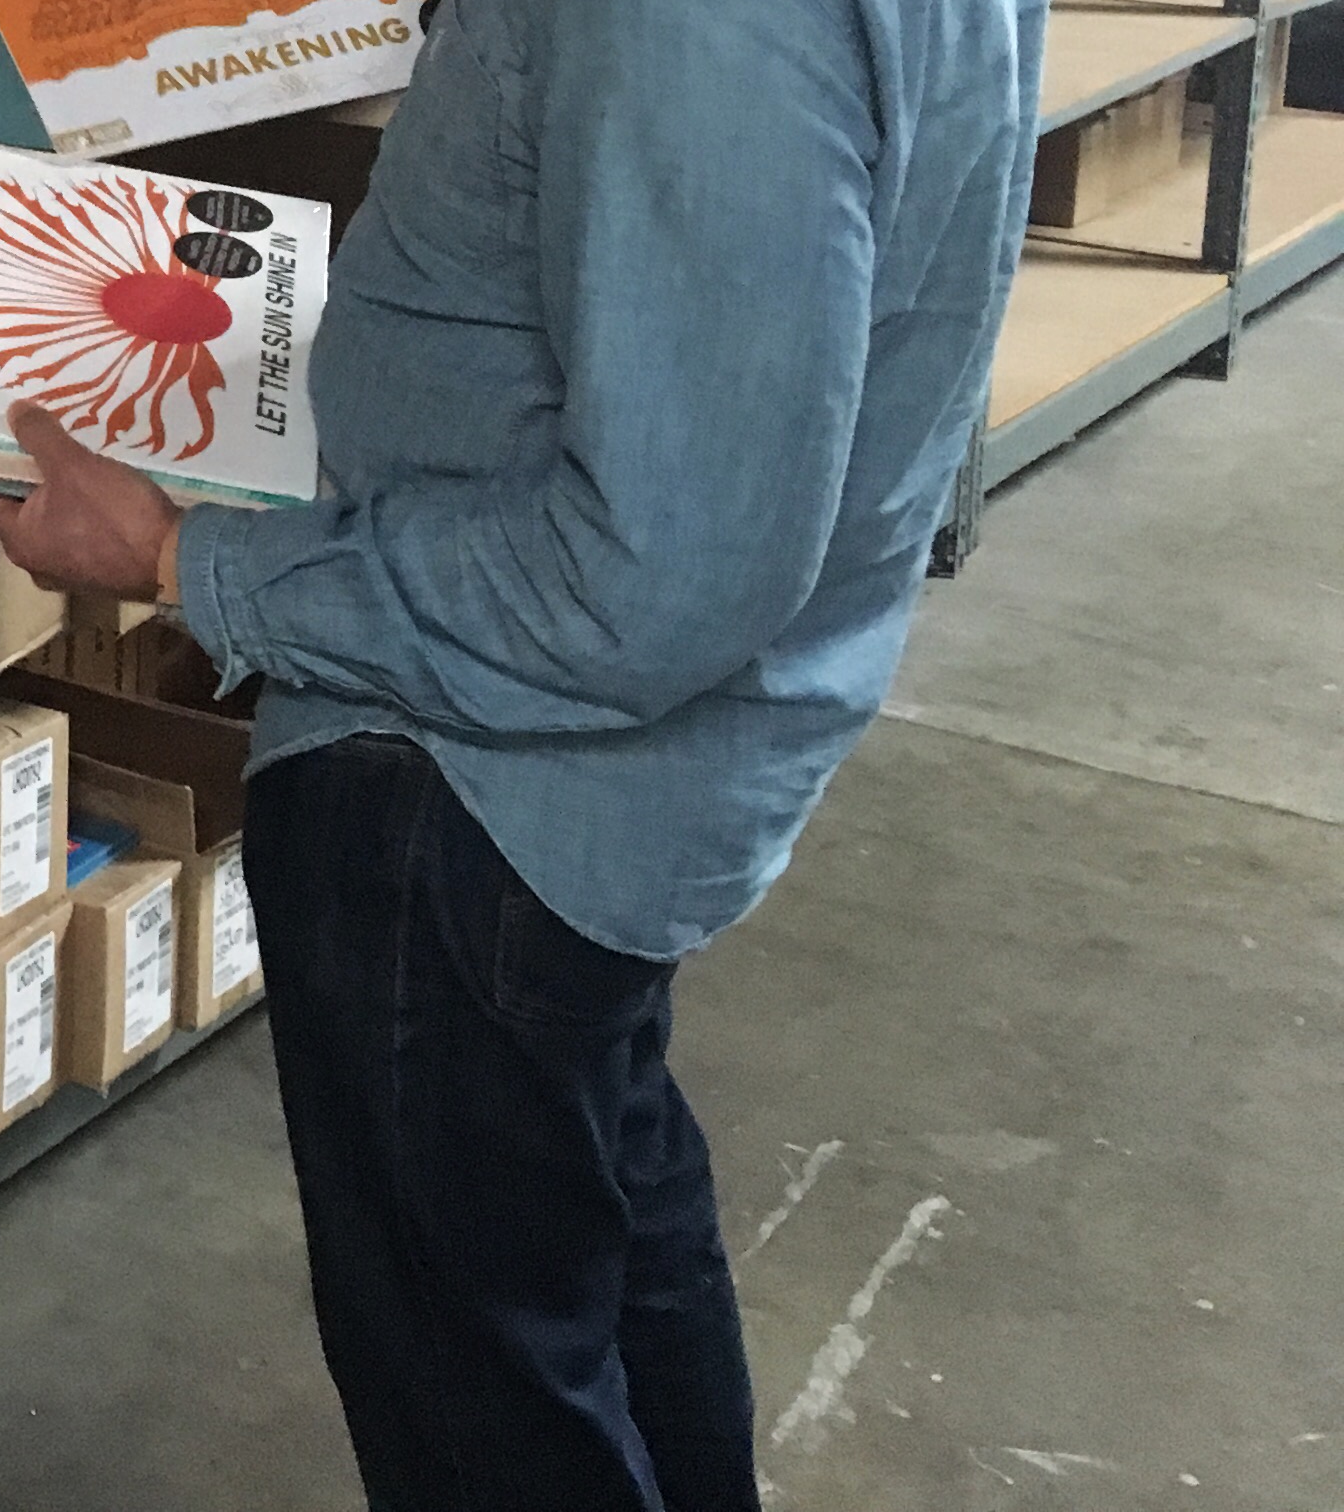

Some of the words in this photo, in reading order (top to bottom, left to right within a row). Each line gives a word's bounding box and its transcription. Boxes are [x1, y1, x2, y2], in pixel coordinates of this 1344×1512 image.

[156, 18, 411, 96] AWAKENING
[270, 231, 297, 254] IN
[265, 251, 296, 308] SHINE
[261, 306, 294, 352] SUN
[258, 349, 289, 392] THE
[255, 392, 287, 437] LET
